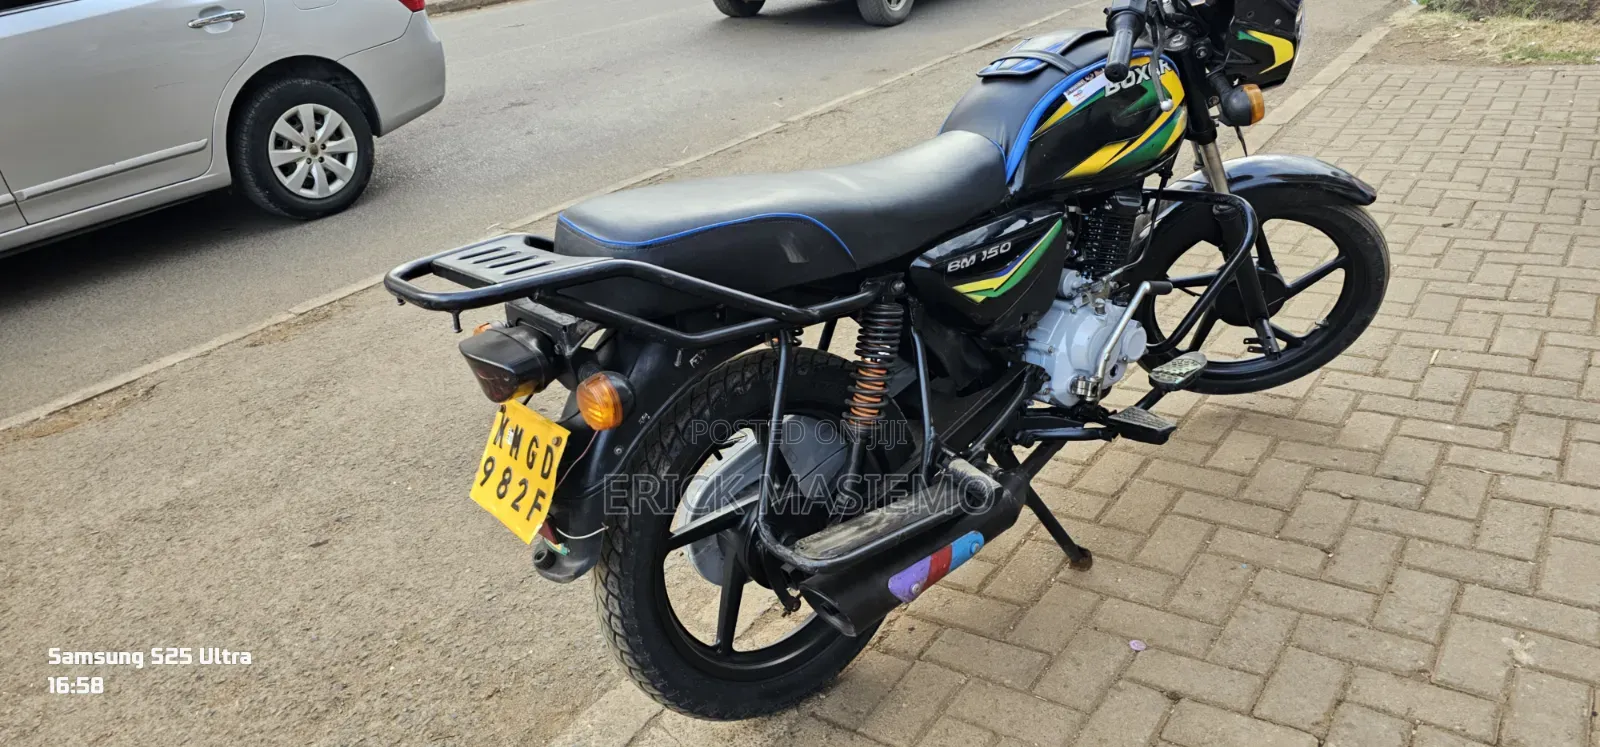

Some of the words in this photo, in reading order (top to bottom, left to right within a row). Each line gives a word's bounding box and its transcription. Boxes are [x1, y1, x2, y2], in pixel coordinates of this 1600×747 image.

[1104, 59, 1172, 97] BOXR
[947, 254, 976, 273] BM
[981, 241, 1012, 262] 150
[493, 411, 554, 480] KMGD
[480, 456, 546, 521] 982F
